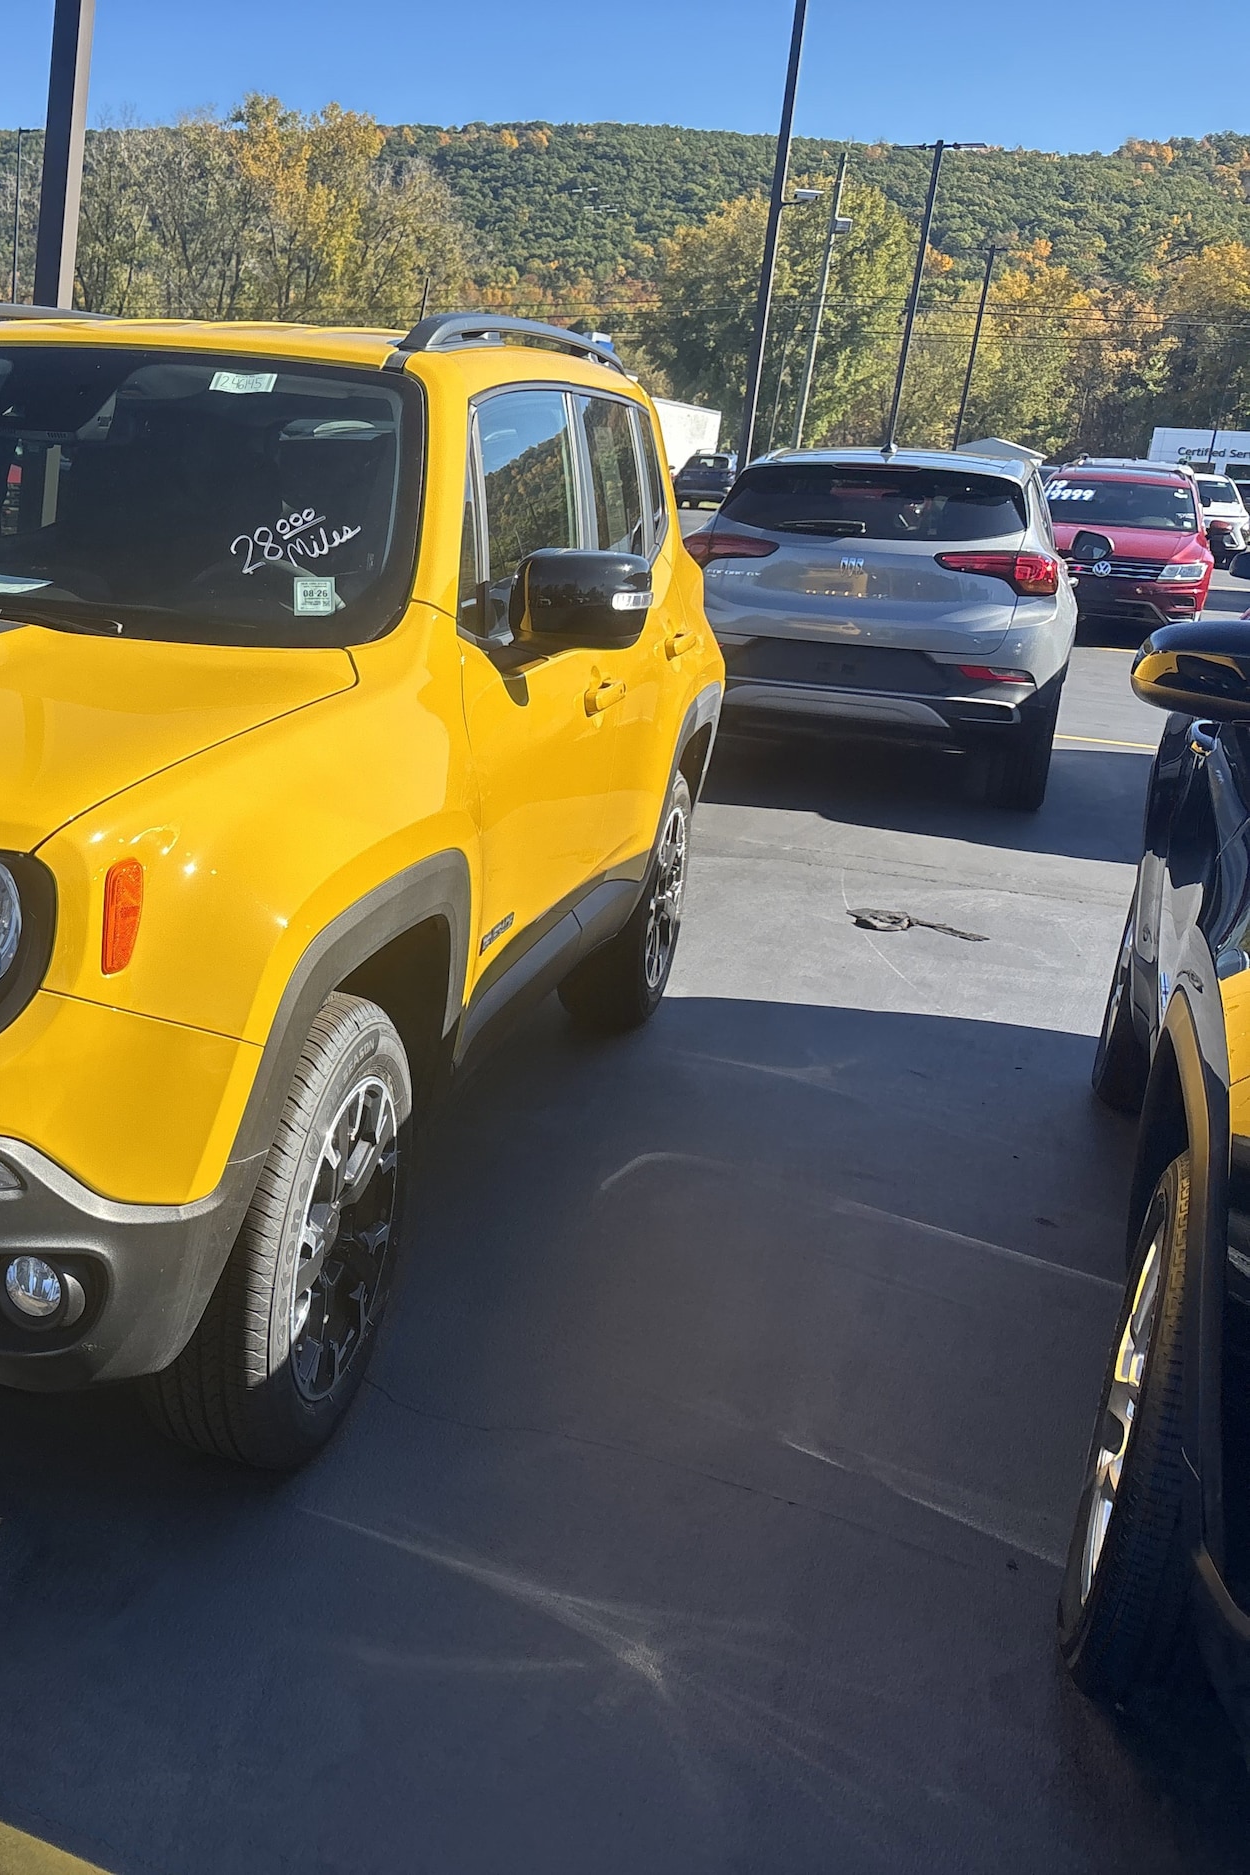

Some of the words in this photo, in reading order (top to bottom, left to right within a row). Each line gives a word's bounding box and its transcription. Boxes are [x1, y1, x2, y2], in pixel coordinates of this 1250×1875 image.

[1177, 446, 1226, 458] Certifed
[286, 525, 362, 567] Miles
[303, 589, 328, 598] 08-26
